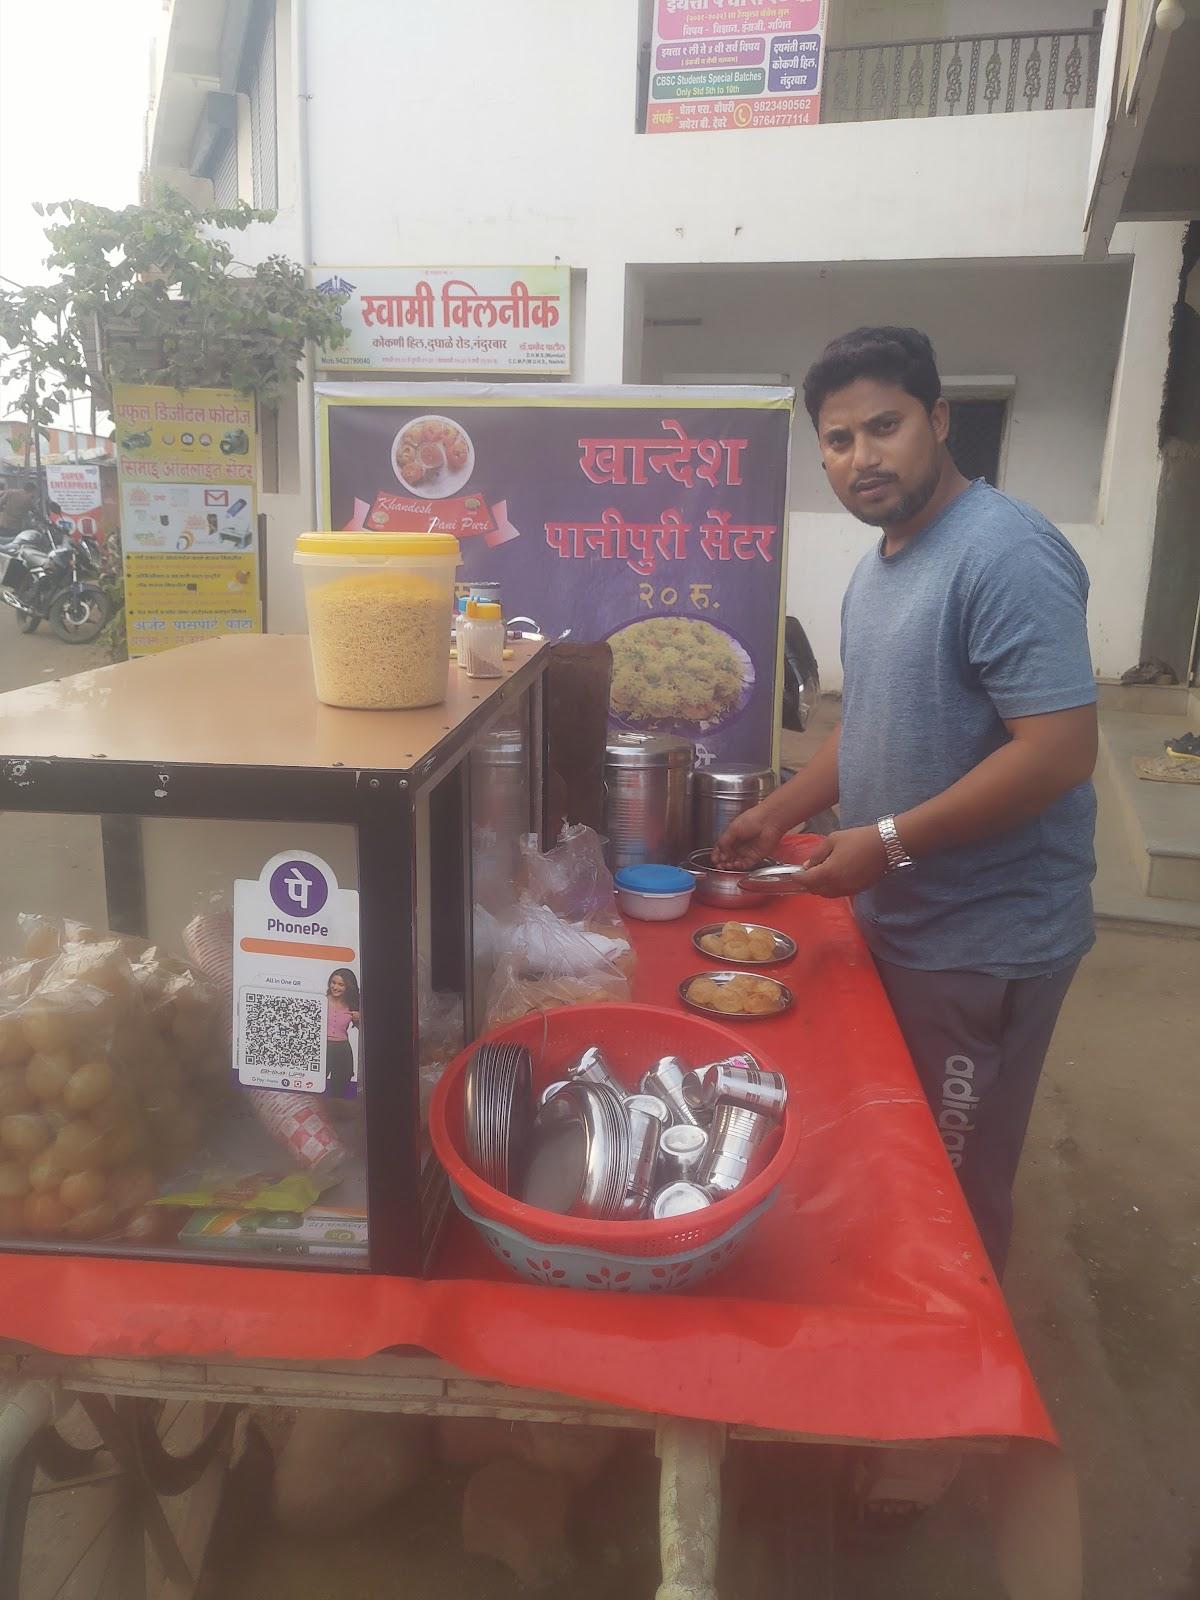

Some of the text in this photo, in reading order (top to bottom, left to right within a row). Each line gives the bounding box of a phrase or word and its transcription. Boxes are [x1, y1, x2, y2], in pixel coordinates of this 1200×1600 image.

[656, 71, 762, 87] CBSC Students Special Batches
[676, 87, 691, 98] Only
[692, 86, 704, 96] Std
[717, 86, 724, 94] to
[753, 99, 811, 112] 9823490562
[752, 113, 809, 126] 9764777114
[361, 279, 560, 328] स्वामी क्लिनीक
[372, 335, 404, 348] कोकणी
[577, 419, 749, 488] खान्देश
[376, 497, 433, 515] Khandesh
[460, 516, 489, 531] Puri
[544, 508, 777, 576] पानीपुरी सेंटर
[639, 582, 678, 609] २०
[267, 918, 329, 937] PhonePe
